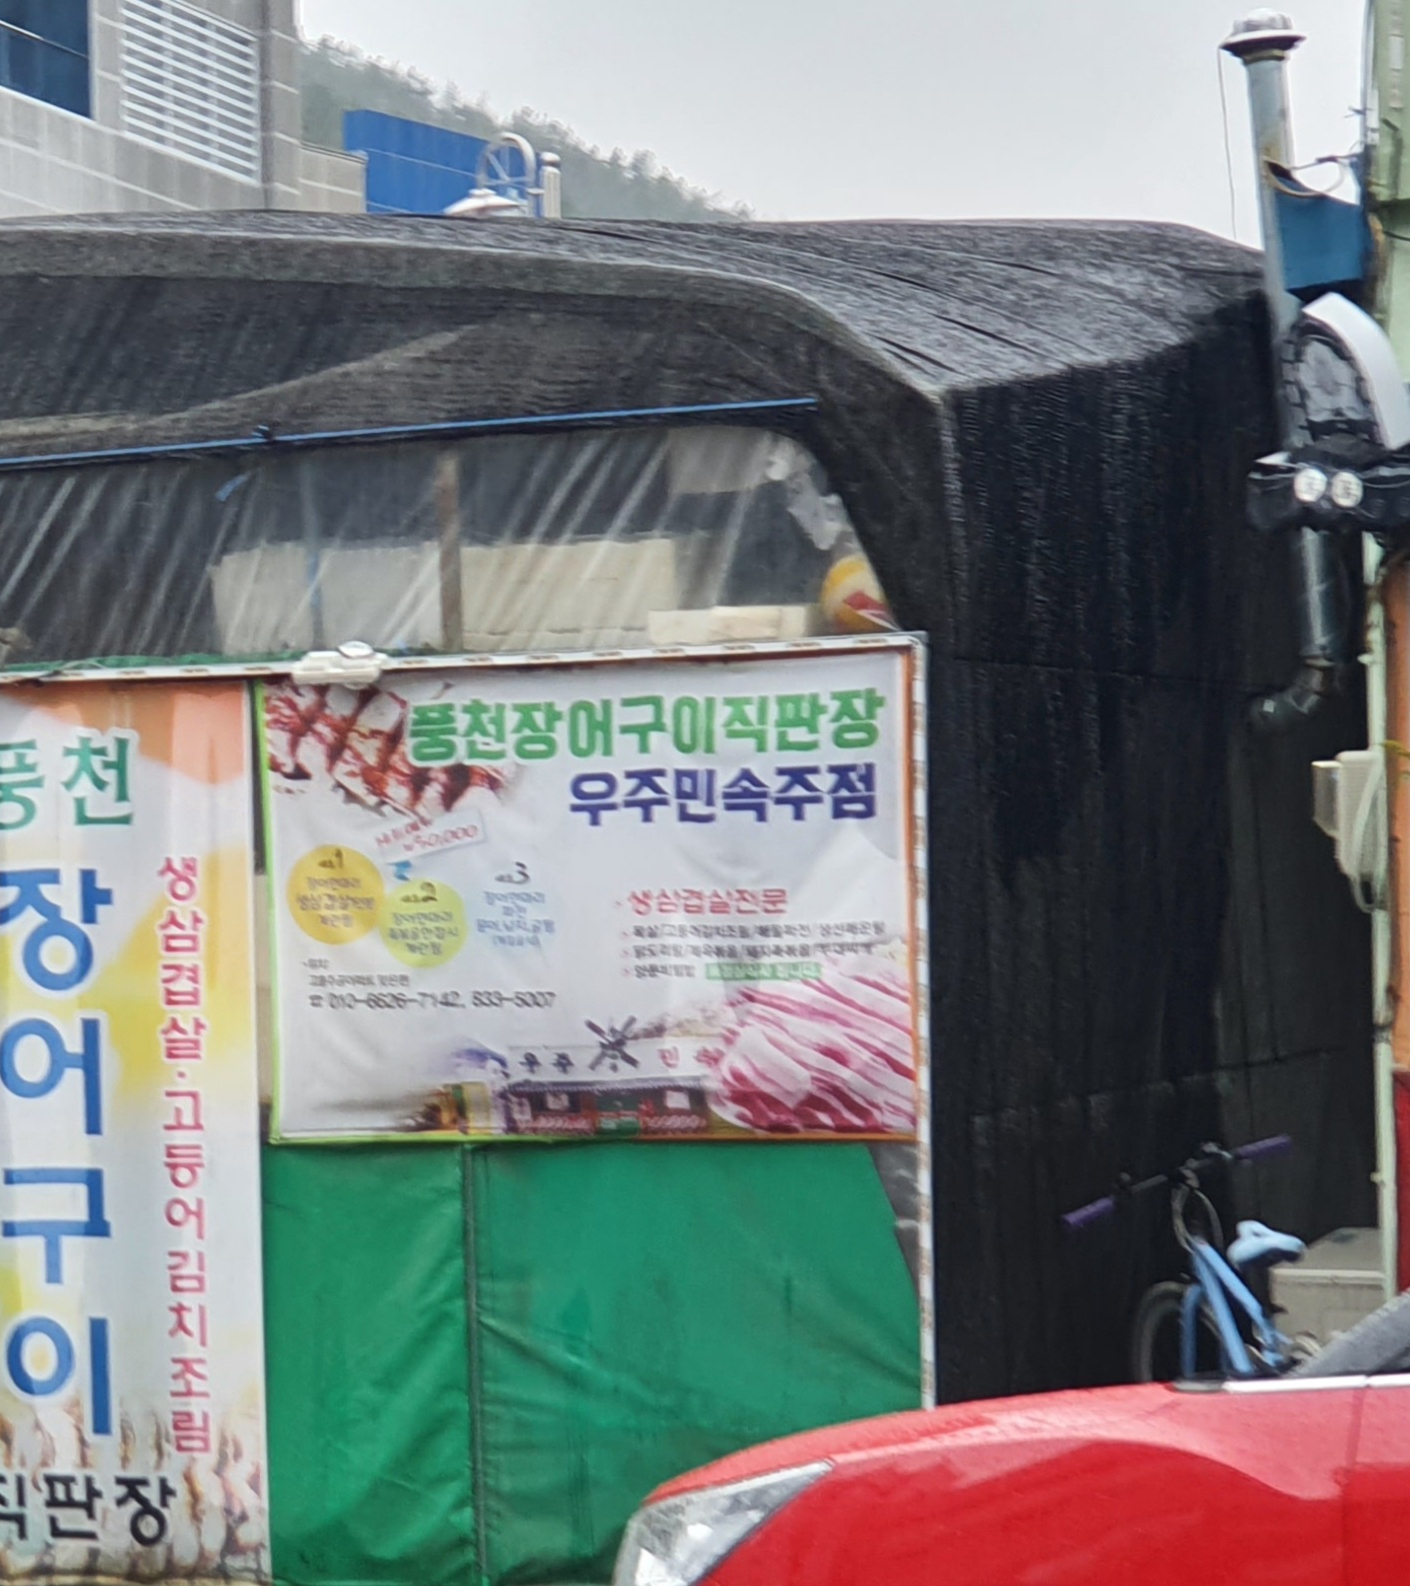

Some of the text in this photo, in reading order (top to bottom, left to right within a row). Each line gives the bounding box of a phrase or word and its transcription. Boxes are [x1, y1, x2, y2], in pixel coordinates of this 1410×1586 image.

[406, 687, 886, 764] 풍천장어구이직판장
[569, 762, 878, 827] 우주민속주점
[628, 888, 788, 915] 생삼겹살전문
